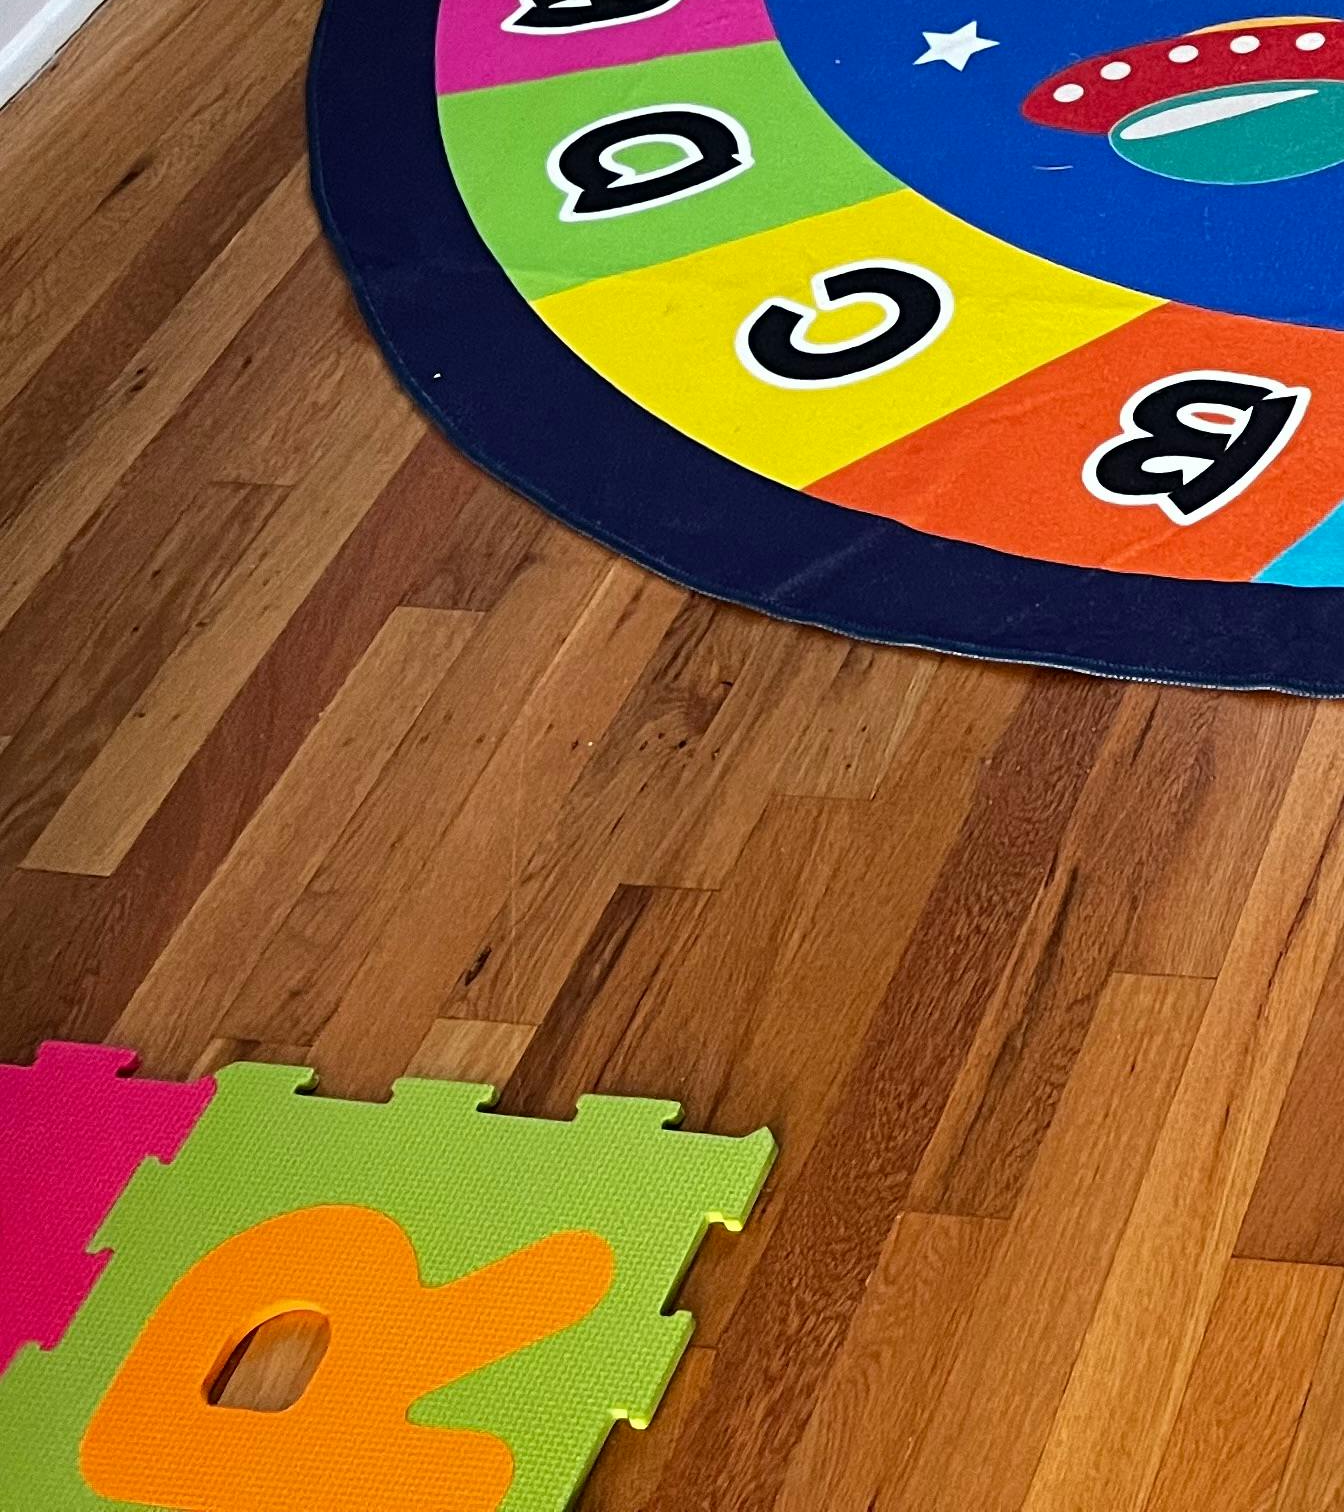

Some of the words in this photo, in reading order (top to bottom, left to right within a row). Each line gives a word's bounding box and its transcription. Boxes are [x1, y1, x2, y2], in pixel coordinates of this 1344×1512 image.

[546, 102, 753, 222] D
[735, 259, 954, 389] C
[1080, 370, 1311, 526] B
[79, 1204, 614, 1512] R
